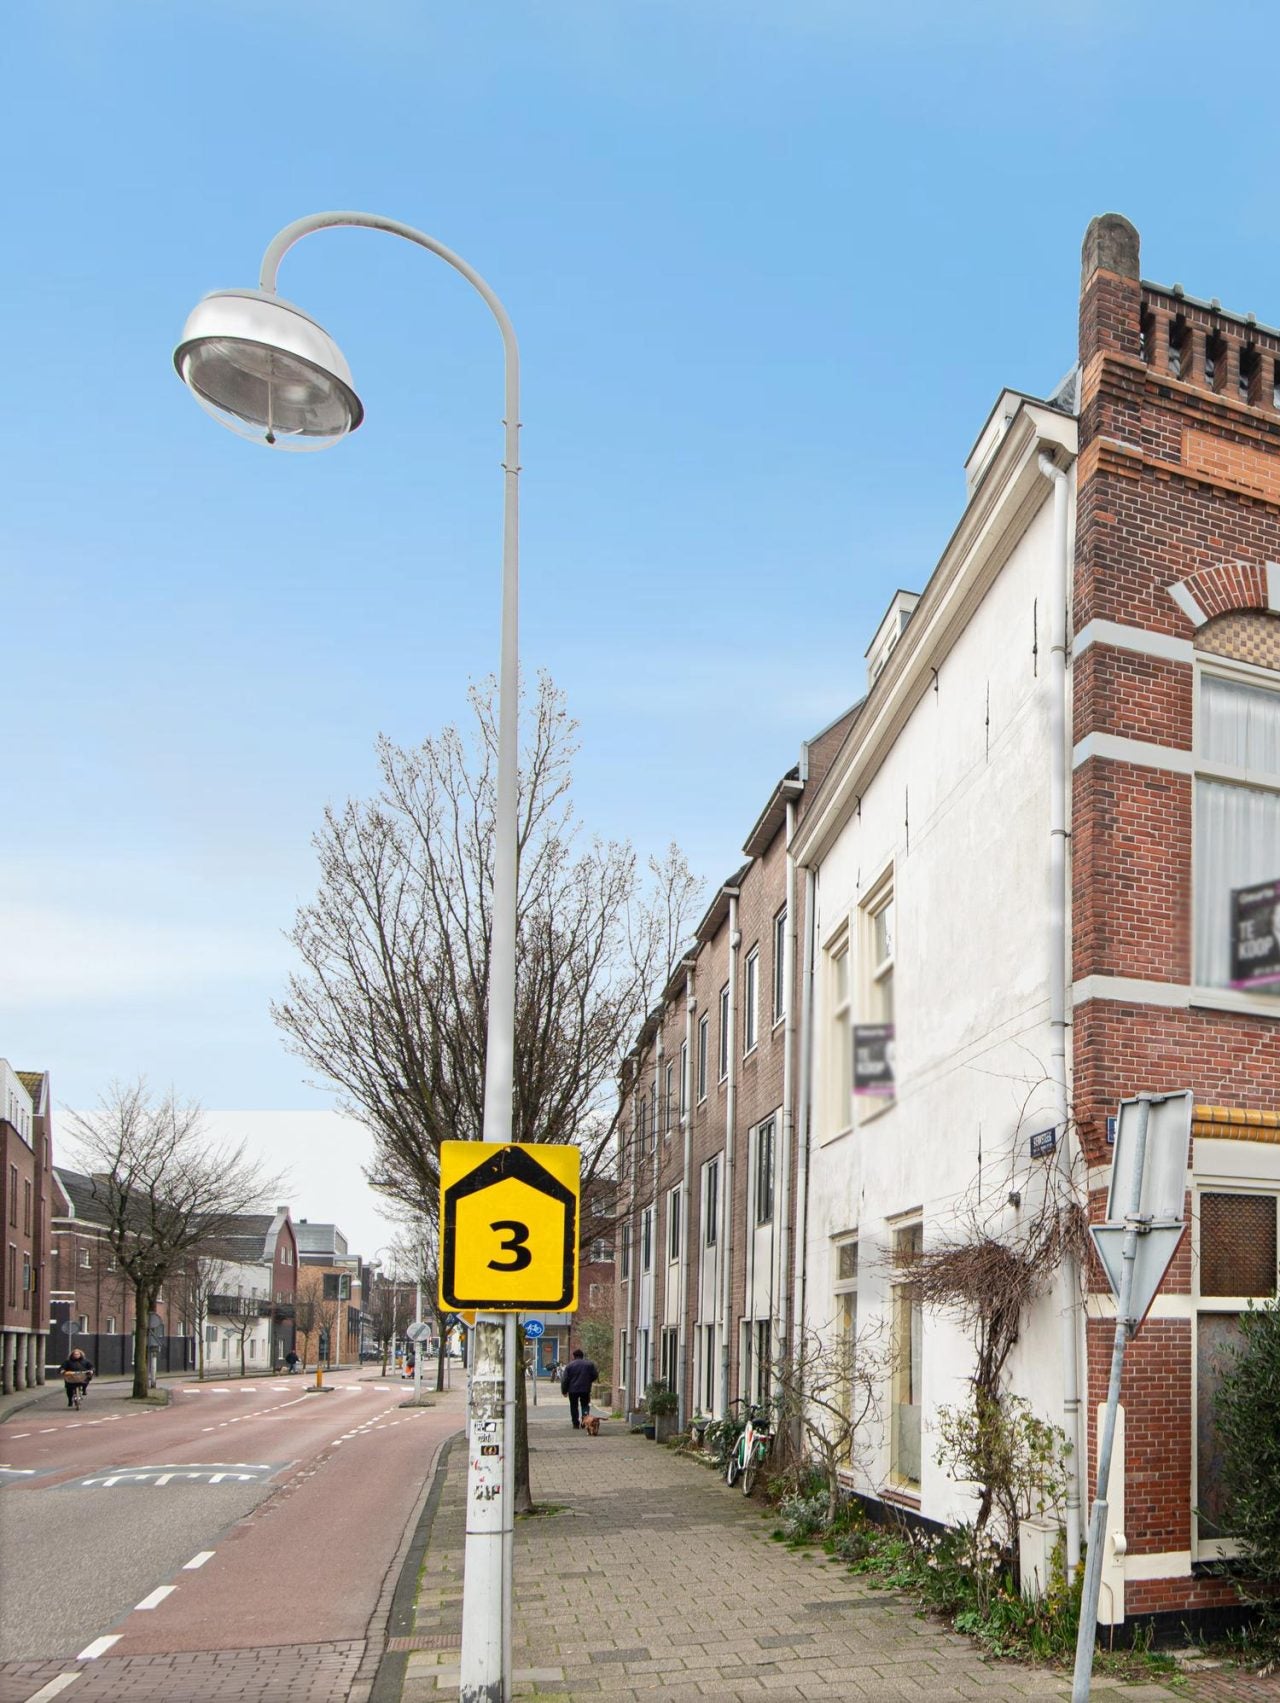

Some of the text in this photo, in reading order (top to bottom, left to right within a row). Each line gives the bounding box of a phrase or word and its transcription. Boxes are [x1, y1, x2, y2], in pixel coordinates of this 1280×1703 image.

[1238, 919, 1255, 942] TE
[1238, 935, 1273, 959] KOOP
[487, 1220, 532, 1272] 3
